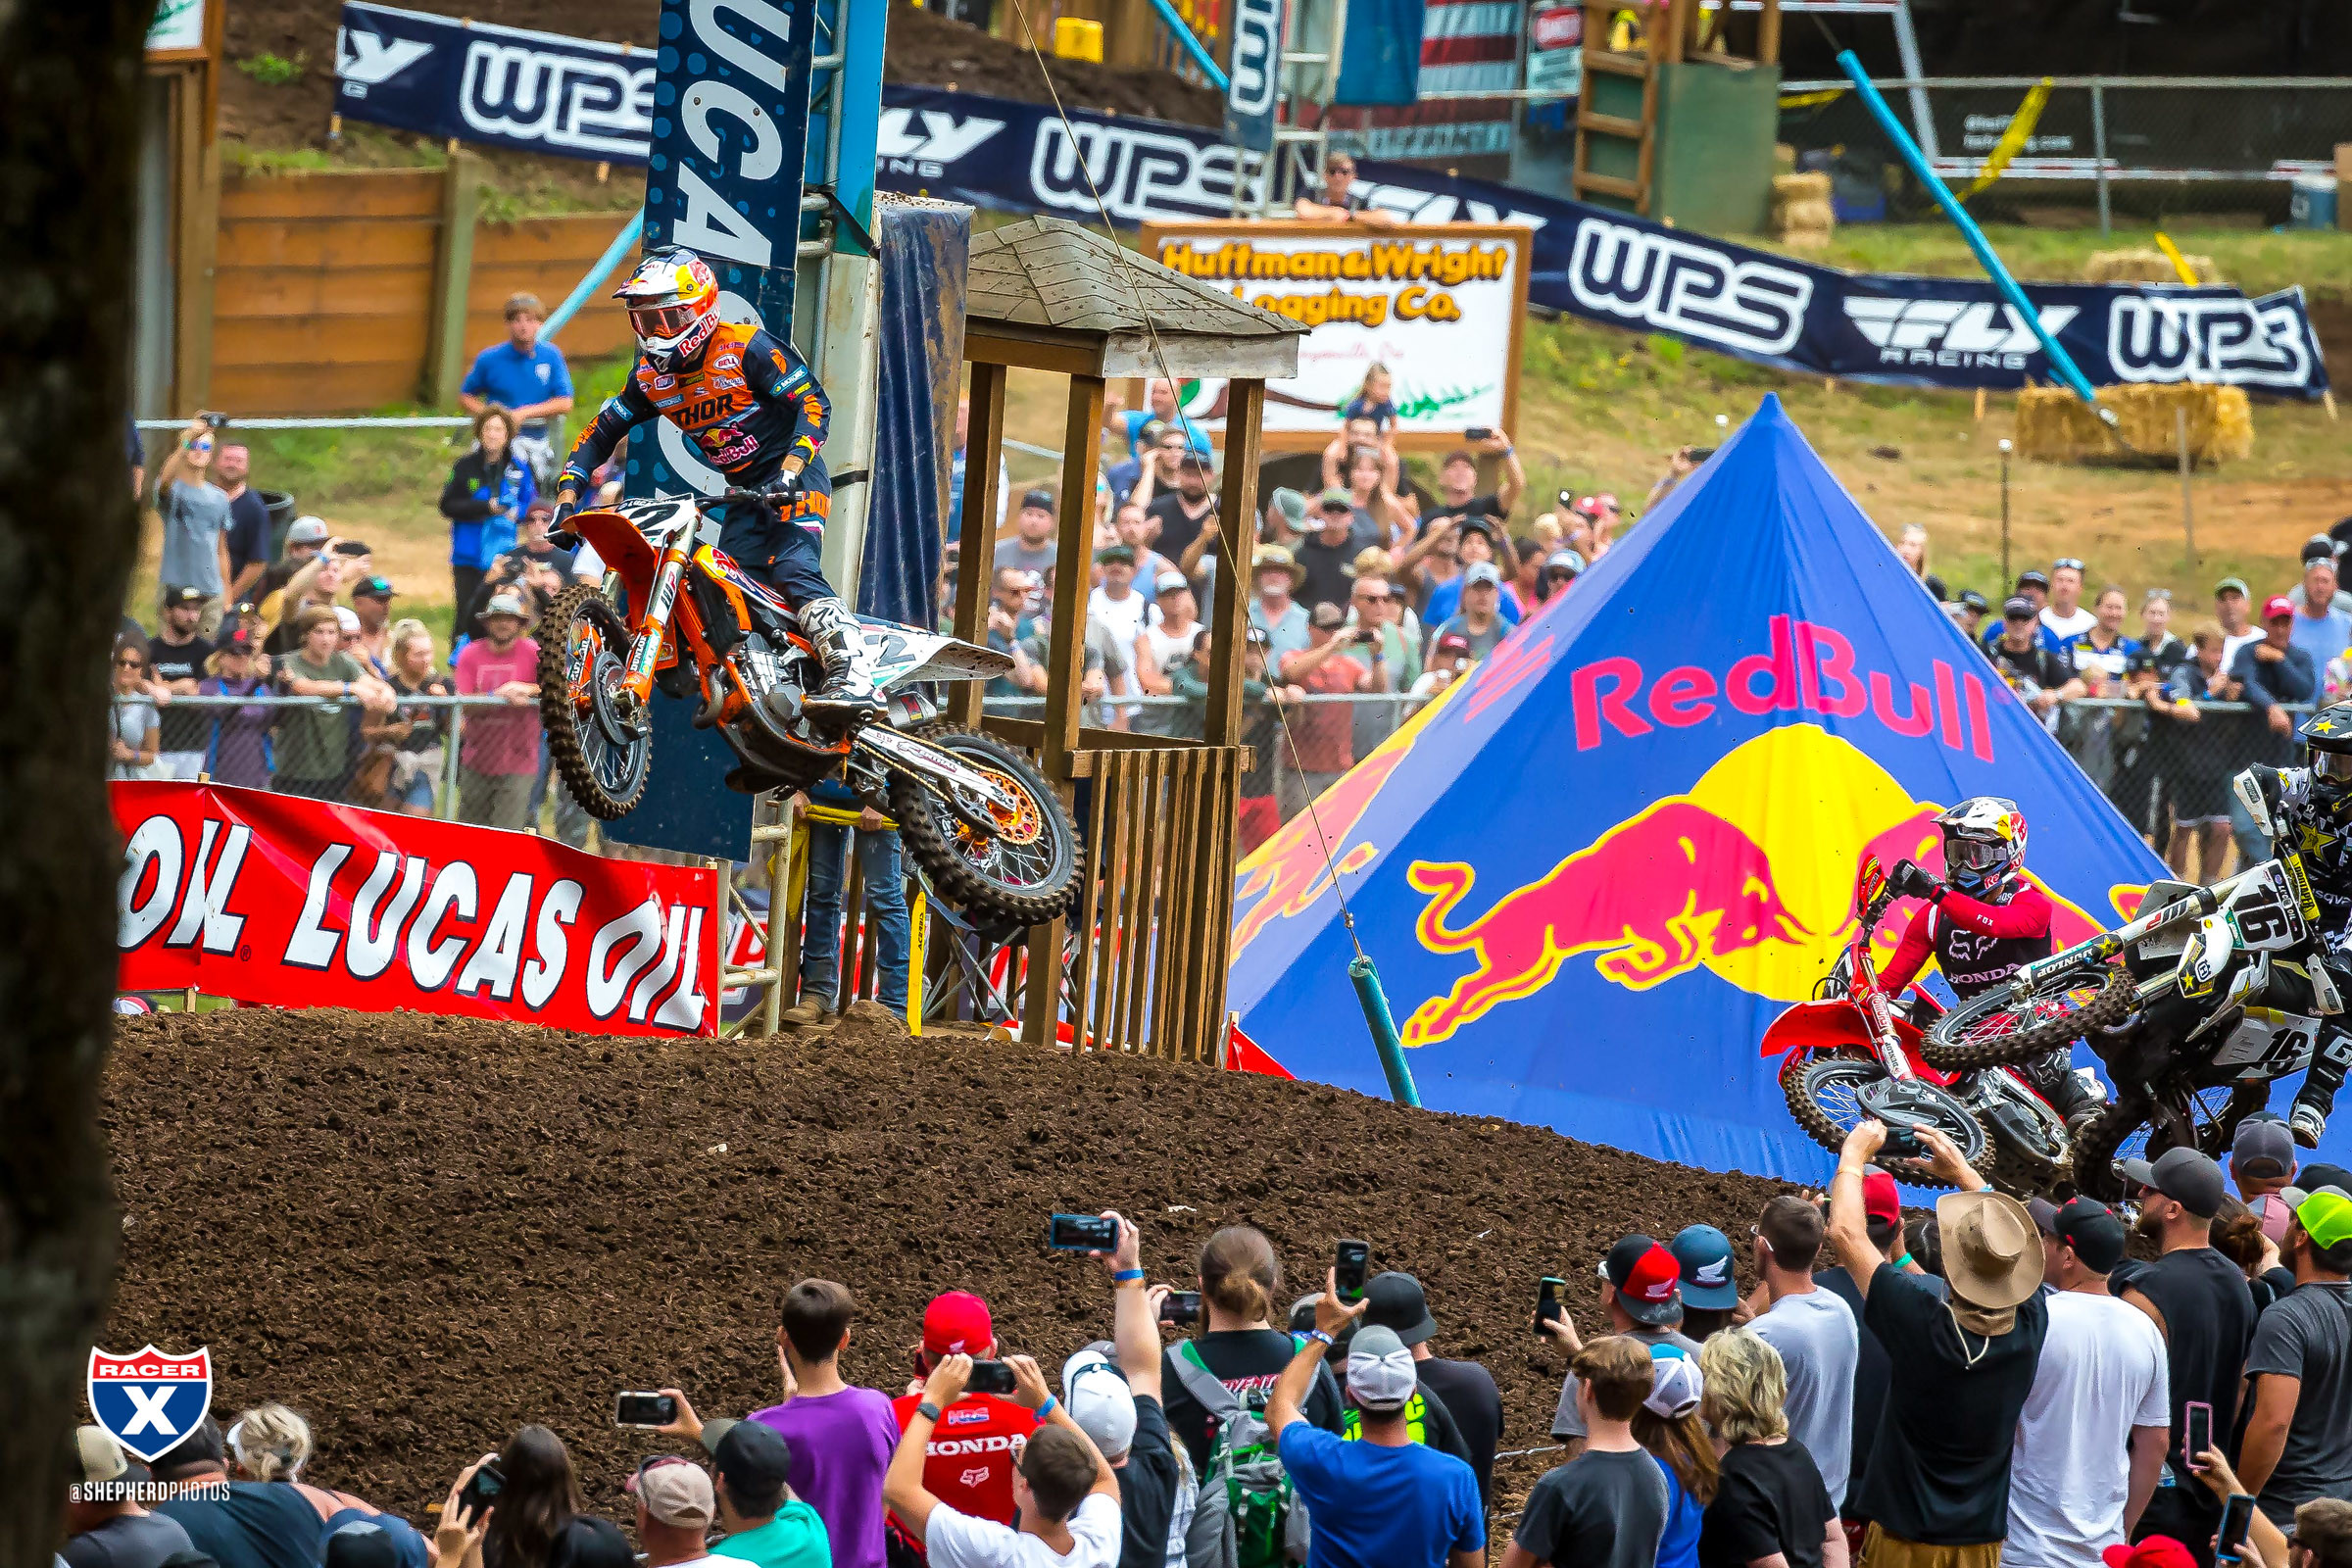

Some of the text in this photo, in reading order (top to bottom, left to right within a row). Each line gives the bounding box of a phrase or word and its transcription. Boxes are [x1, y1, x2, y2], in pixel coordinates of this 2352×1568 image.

[1162, 242, 1341, 279] Huffman
[1372, 243, 1508, 286] Wright
[1231, 285, 1388, 327] ogging
[1569, 218, 1814, 356] WPS
[717, 358, 736, 368] BELL
[1880, 349, 2028, 370] RACING
[671, 393, 735, 426] THOR
[117, 813, 254, 957] OIL
[280, 843, 587, 1013] LUCAS
[586, 898, 707, 1035] OIL
[1976, 913, 1994, 927] FOX
[2233, 883, 2288, 944] 16
[1885, 1041, 1899, 1070] DUNLOP
[2257, 1027, 2309, 1075] 16
